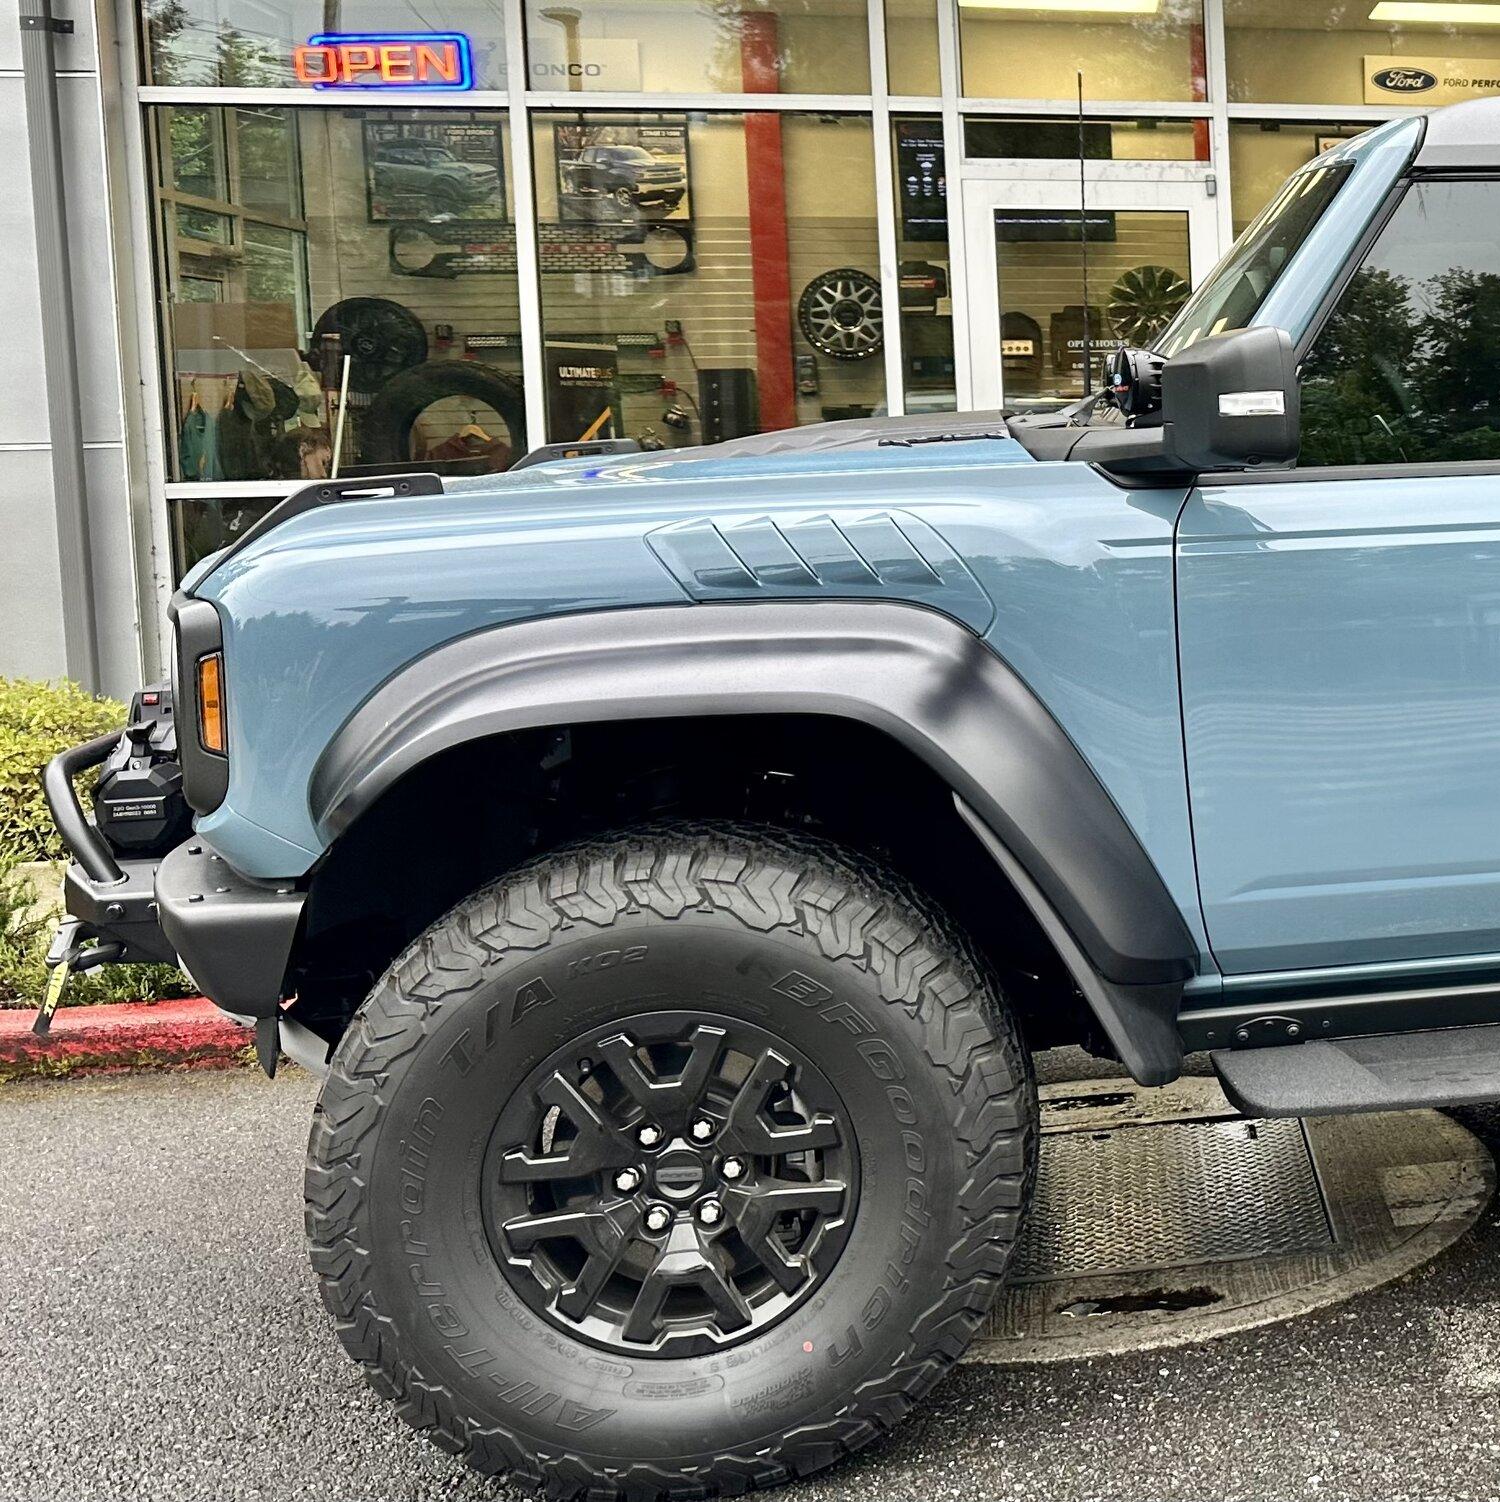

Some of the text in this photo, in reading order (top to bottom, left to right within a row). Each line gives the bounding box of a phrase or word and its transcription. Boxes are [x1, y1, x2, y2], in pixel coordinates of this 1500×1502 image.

[294, 44, 458, 82] OPEN
[498, 63, 600, 76] BONCO
[1443, 78, 1469, 87] FORD
[1095, 339, 1129, 347] HOURS
[565, 946, 648, 980] KO2
[437, 976, 557, 1078] T/A
[771, 970, 931, 1370] BFGoodrich
[400, 1097, 618, 1432] All-Terrain
